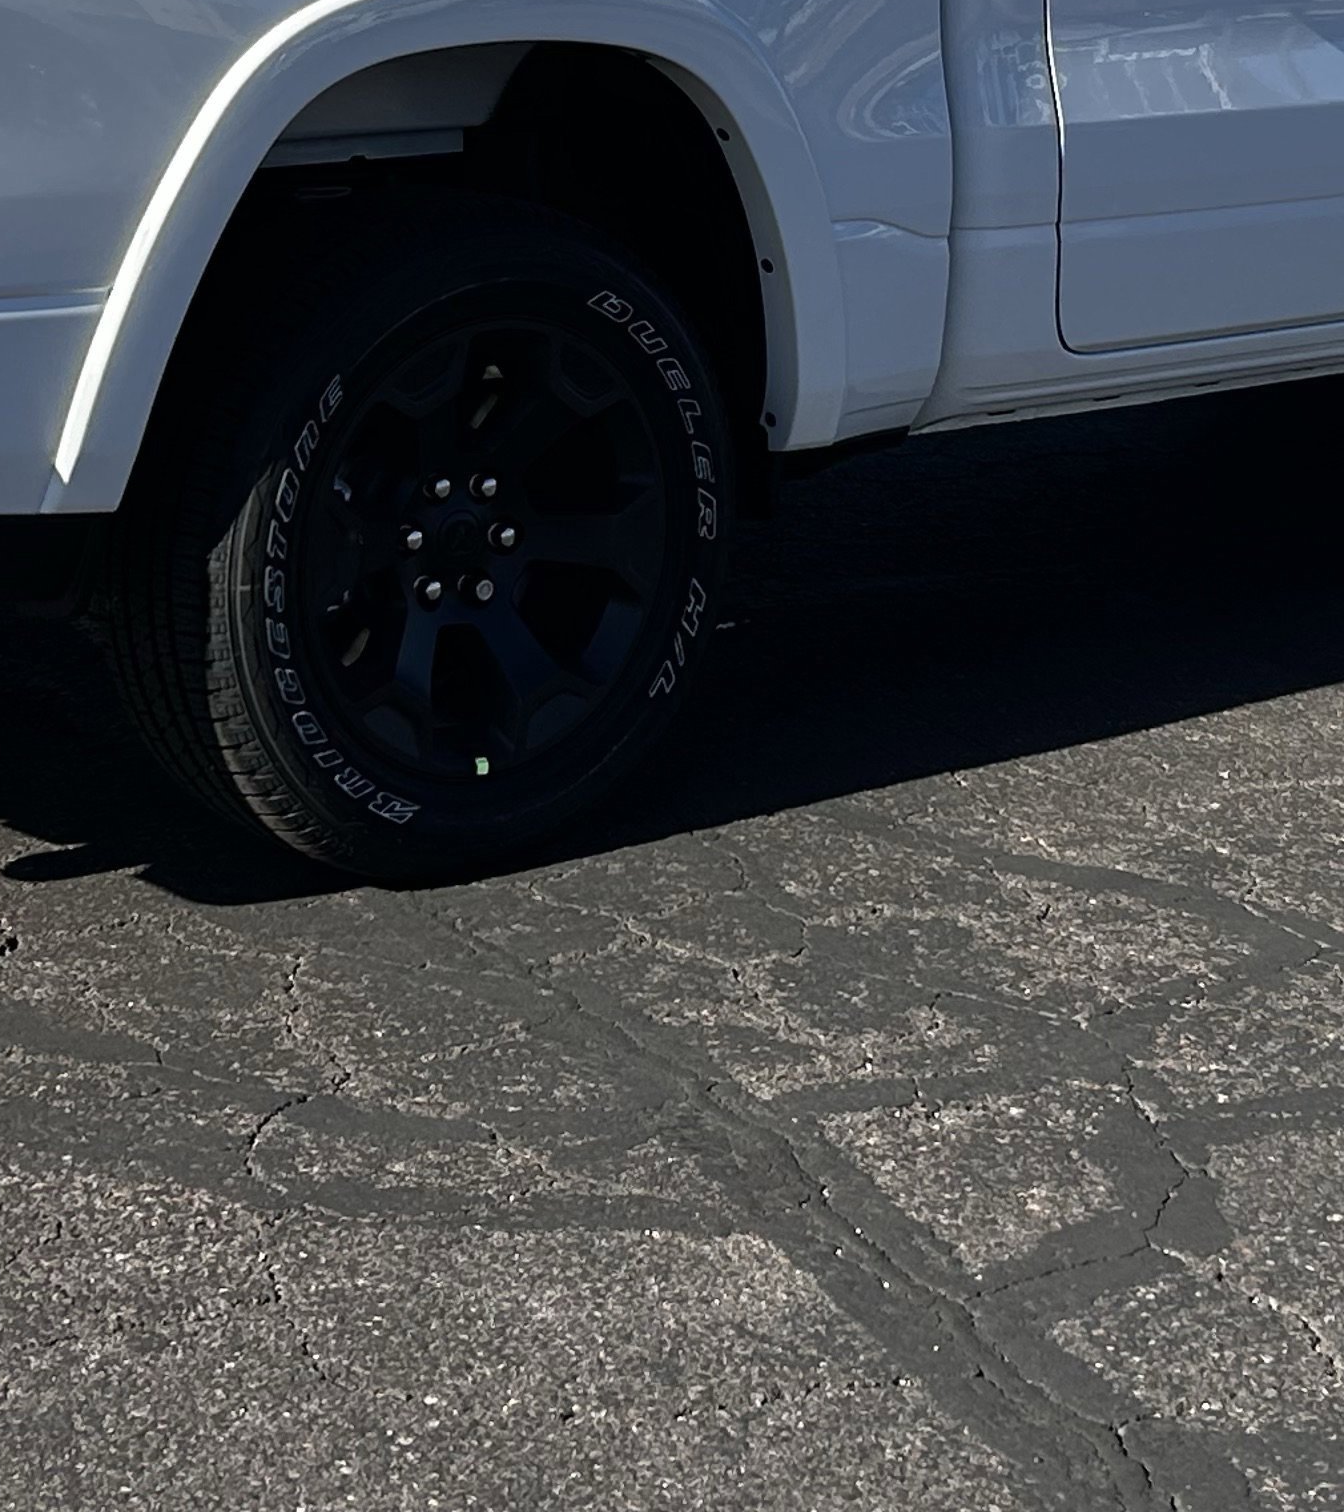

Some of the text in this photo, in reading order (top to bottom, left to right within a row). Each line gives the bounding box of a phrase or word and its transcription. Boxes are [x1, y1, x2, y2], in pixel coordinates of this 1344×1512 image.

[263, 373, 422, 824] BRIDGESTONE
[587, 289, 718, 699] DUELER H/L
